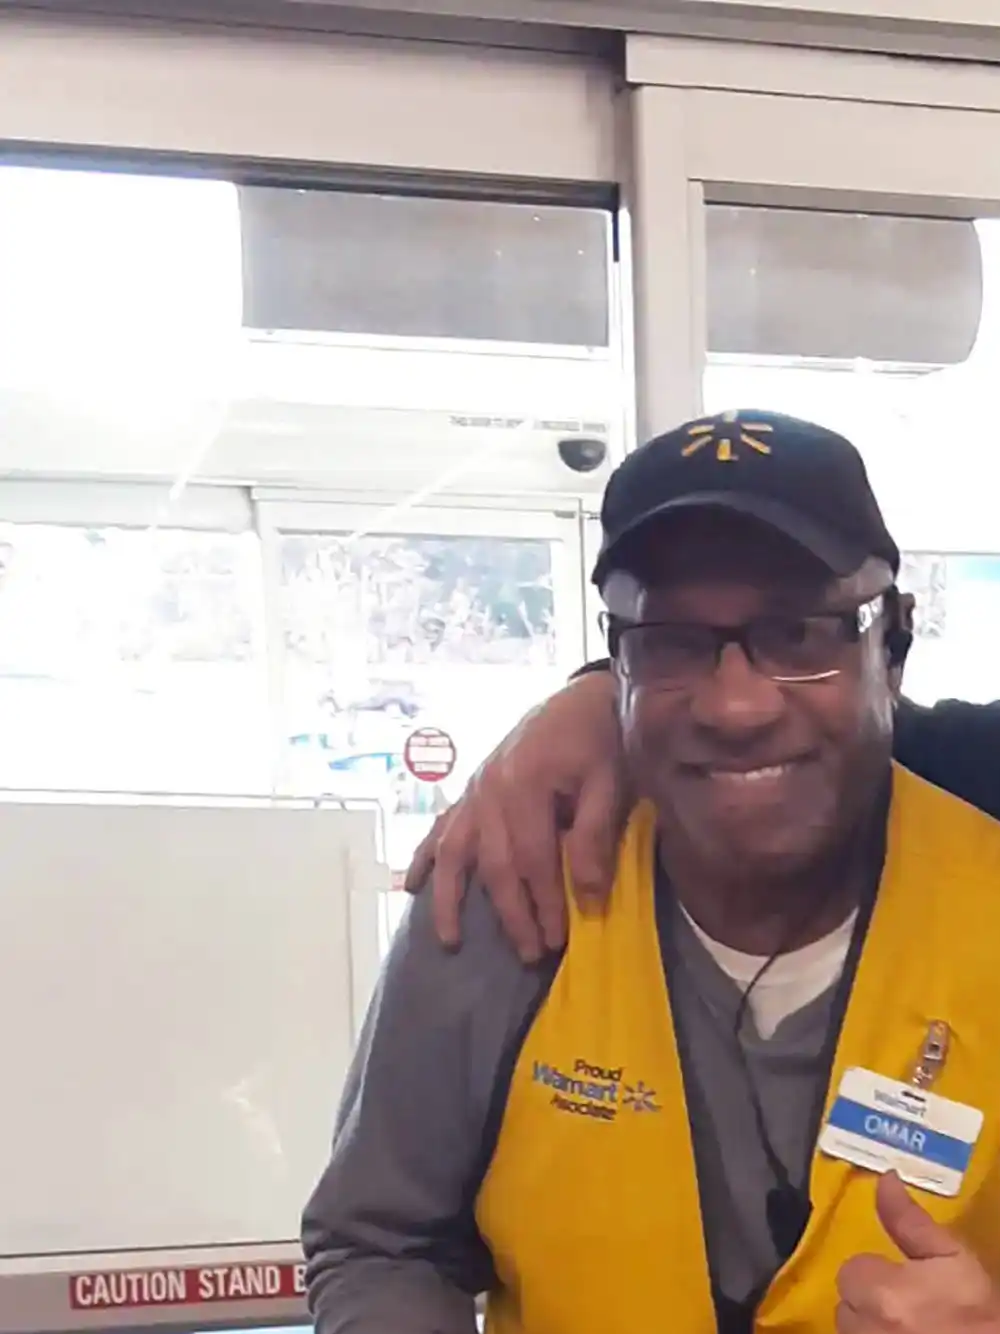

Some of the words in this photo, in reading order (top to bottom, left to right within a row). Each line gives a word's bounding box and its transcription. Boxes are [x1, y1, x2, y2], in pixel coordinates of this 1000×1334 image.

[574, 1059, 623, 1081] Proud
[864, 1114, 926, 1152] OMAR
[75, 1271, 187, 1306] CAUTION
[197, 1264, 282, 1299] STAND
